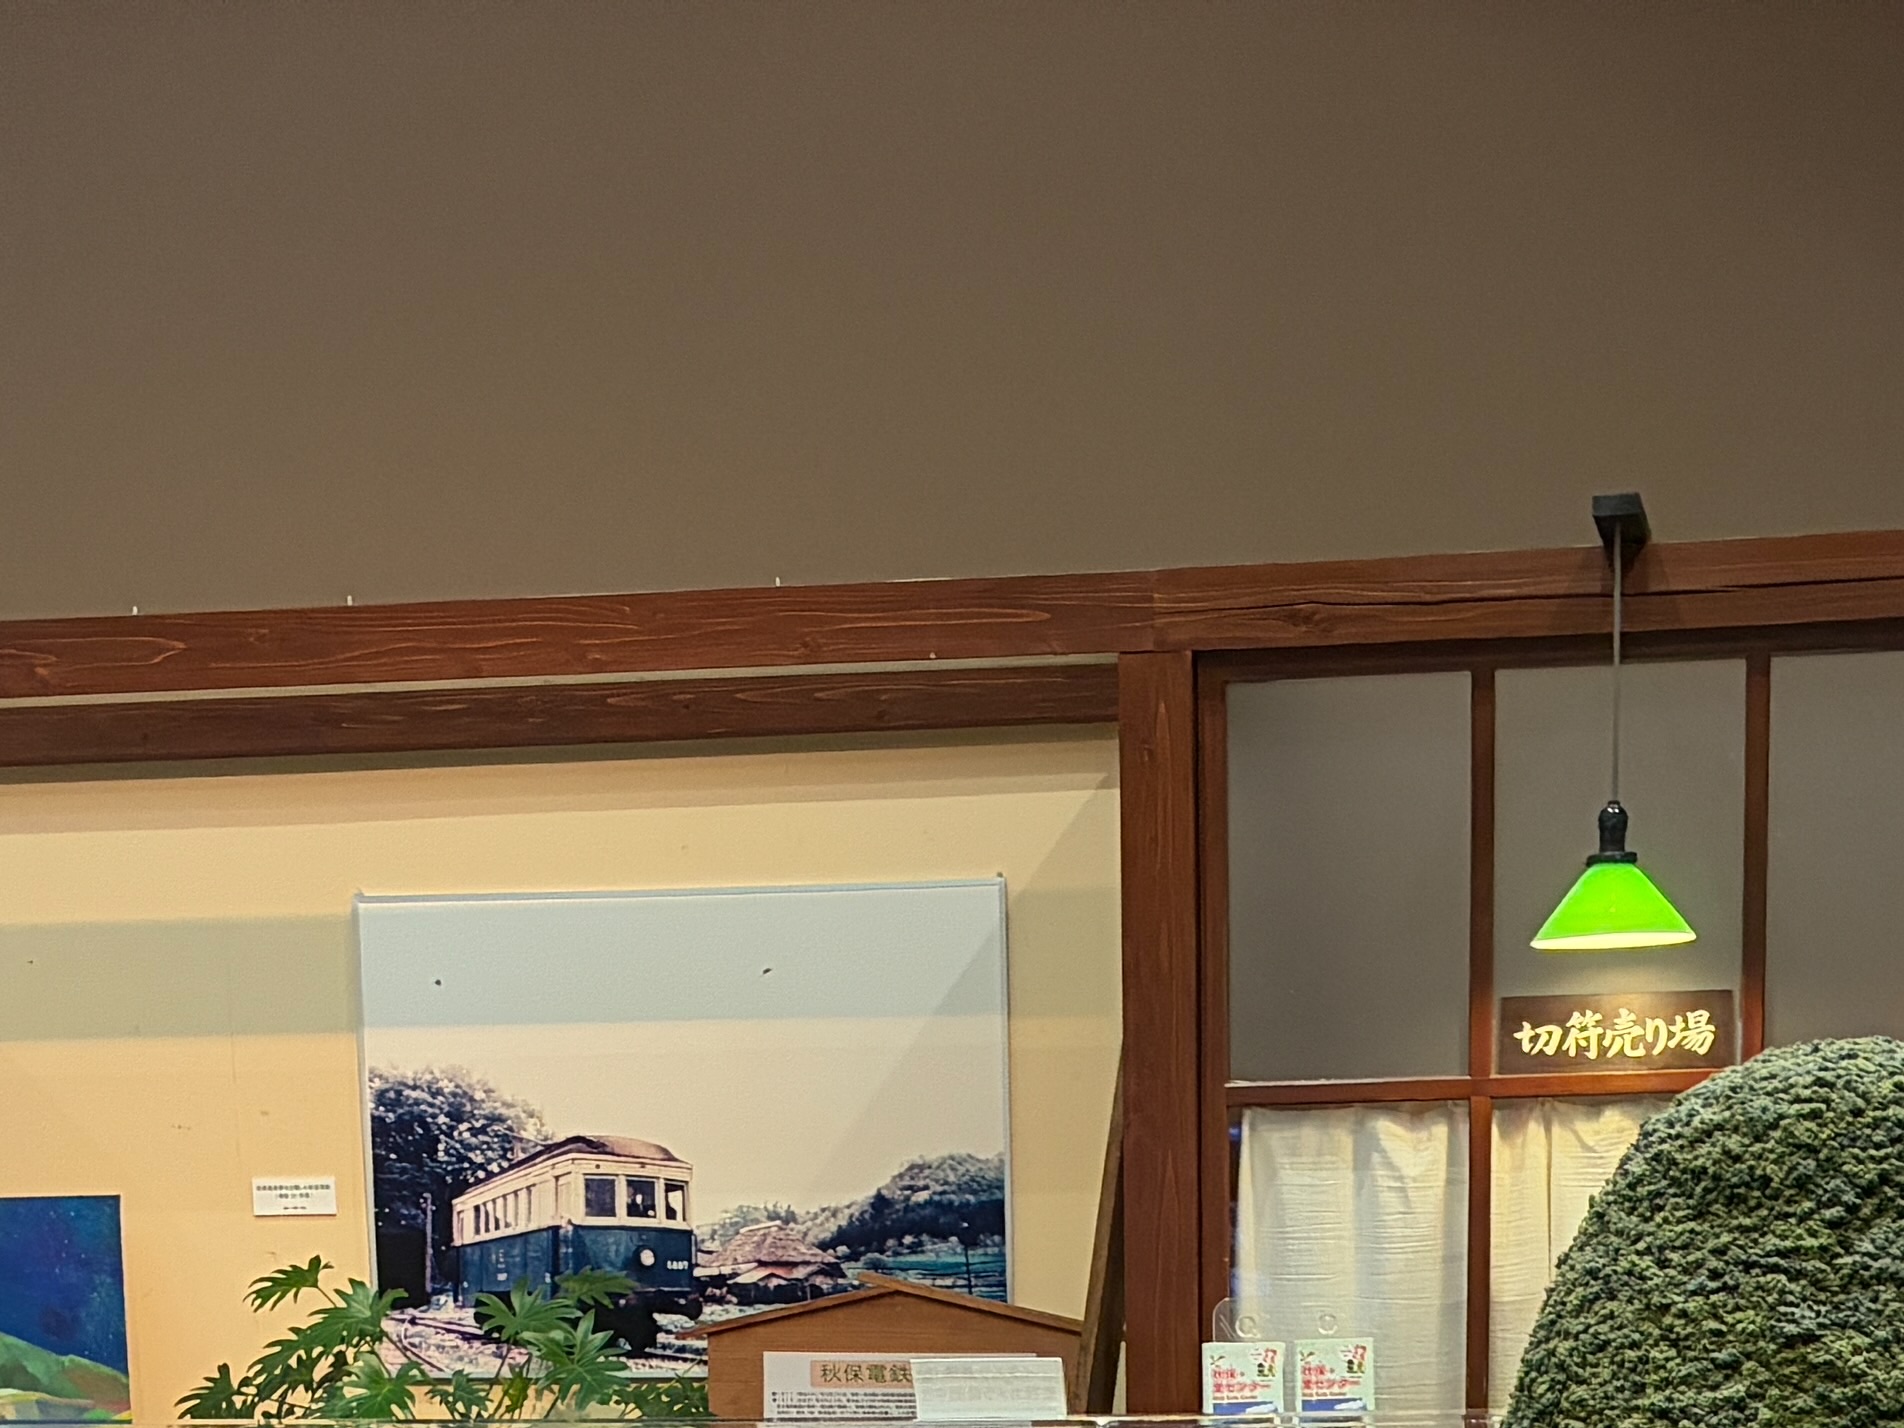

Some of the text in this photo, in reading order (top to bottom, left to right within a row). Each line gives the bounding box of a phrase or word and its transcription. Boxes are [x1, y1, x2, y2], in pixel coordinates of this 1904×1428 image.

[1513, 1008, 1716, 1060] 切符売り場
